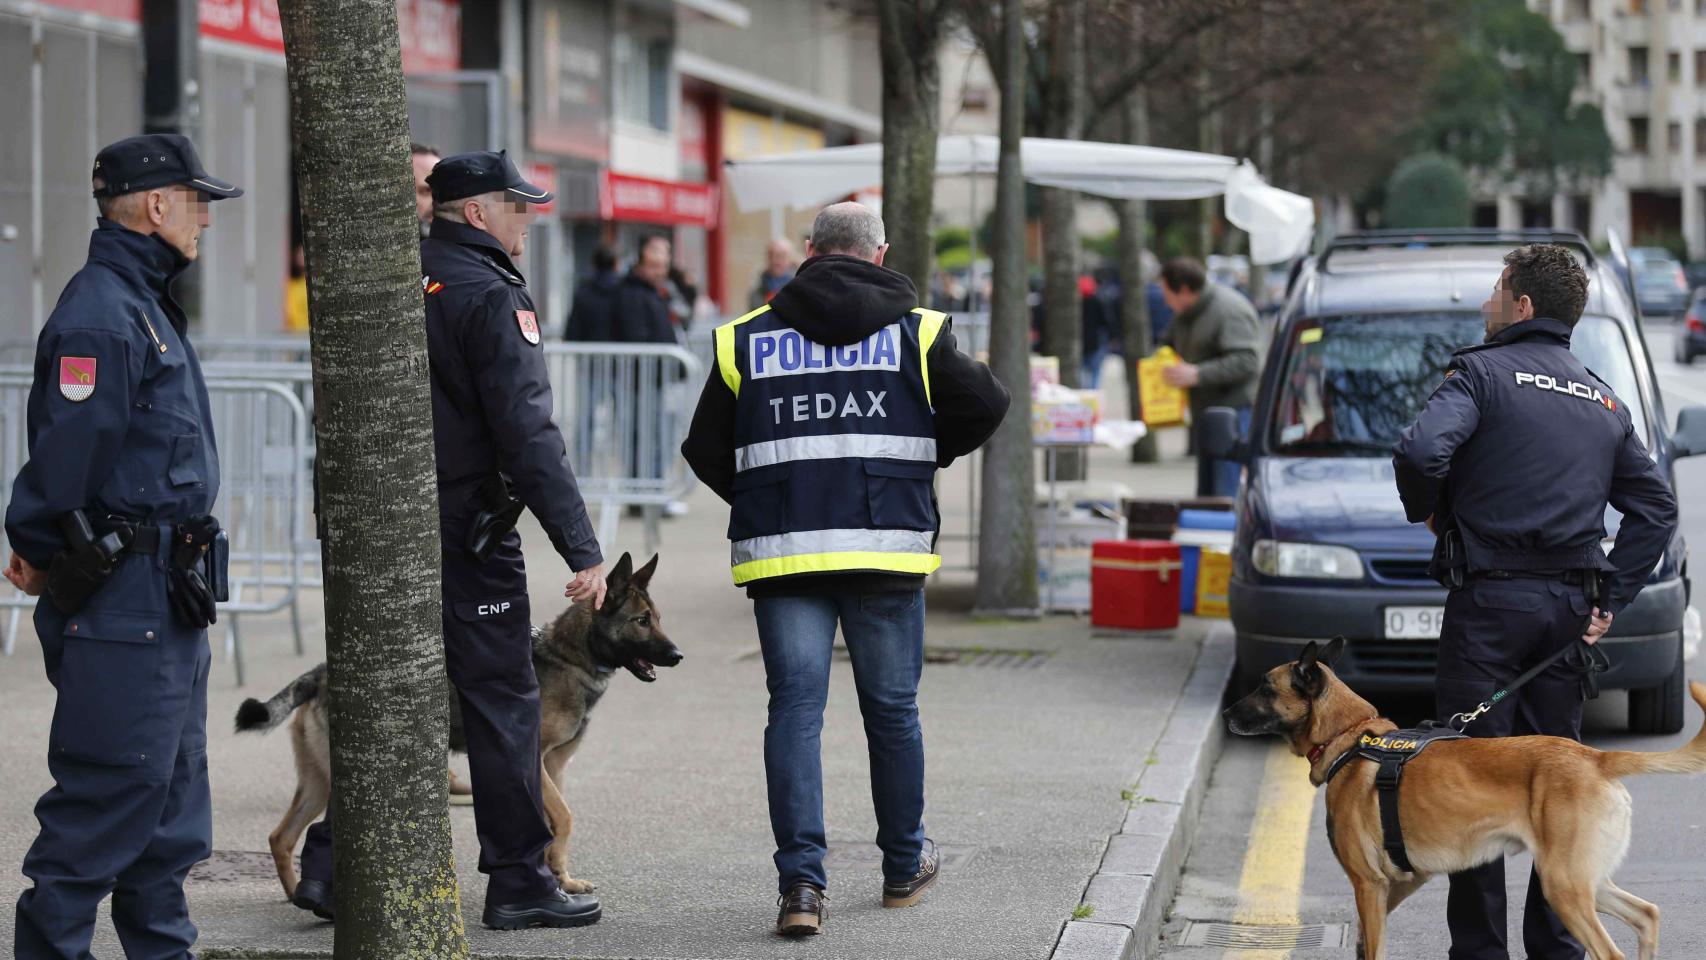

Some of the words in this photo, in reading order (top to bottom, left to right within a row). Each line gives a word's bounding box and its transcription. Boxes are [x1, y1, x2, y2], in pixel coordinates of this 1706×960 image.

[755, 328, 897, 374] POLICIA
[1515, 372, 1605, 404] POLICIA
[769, 390, 888, 425] TEDAX
[477, 601, 511, 616] CNP
[1360, 734, 1417, 750] POLICIA
